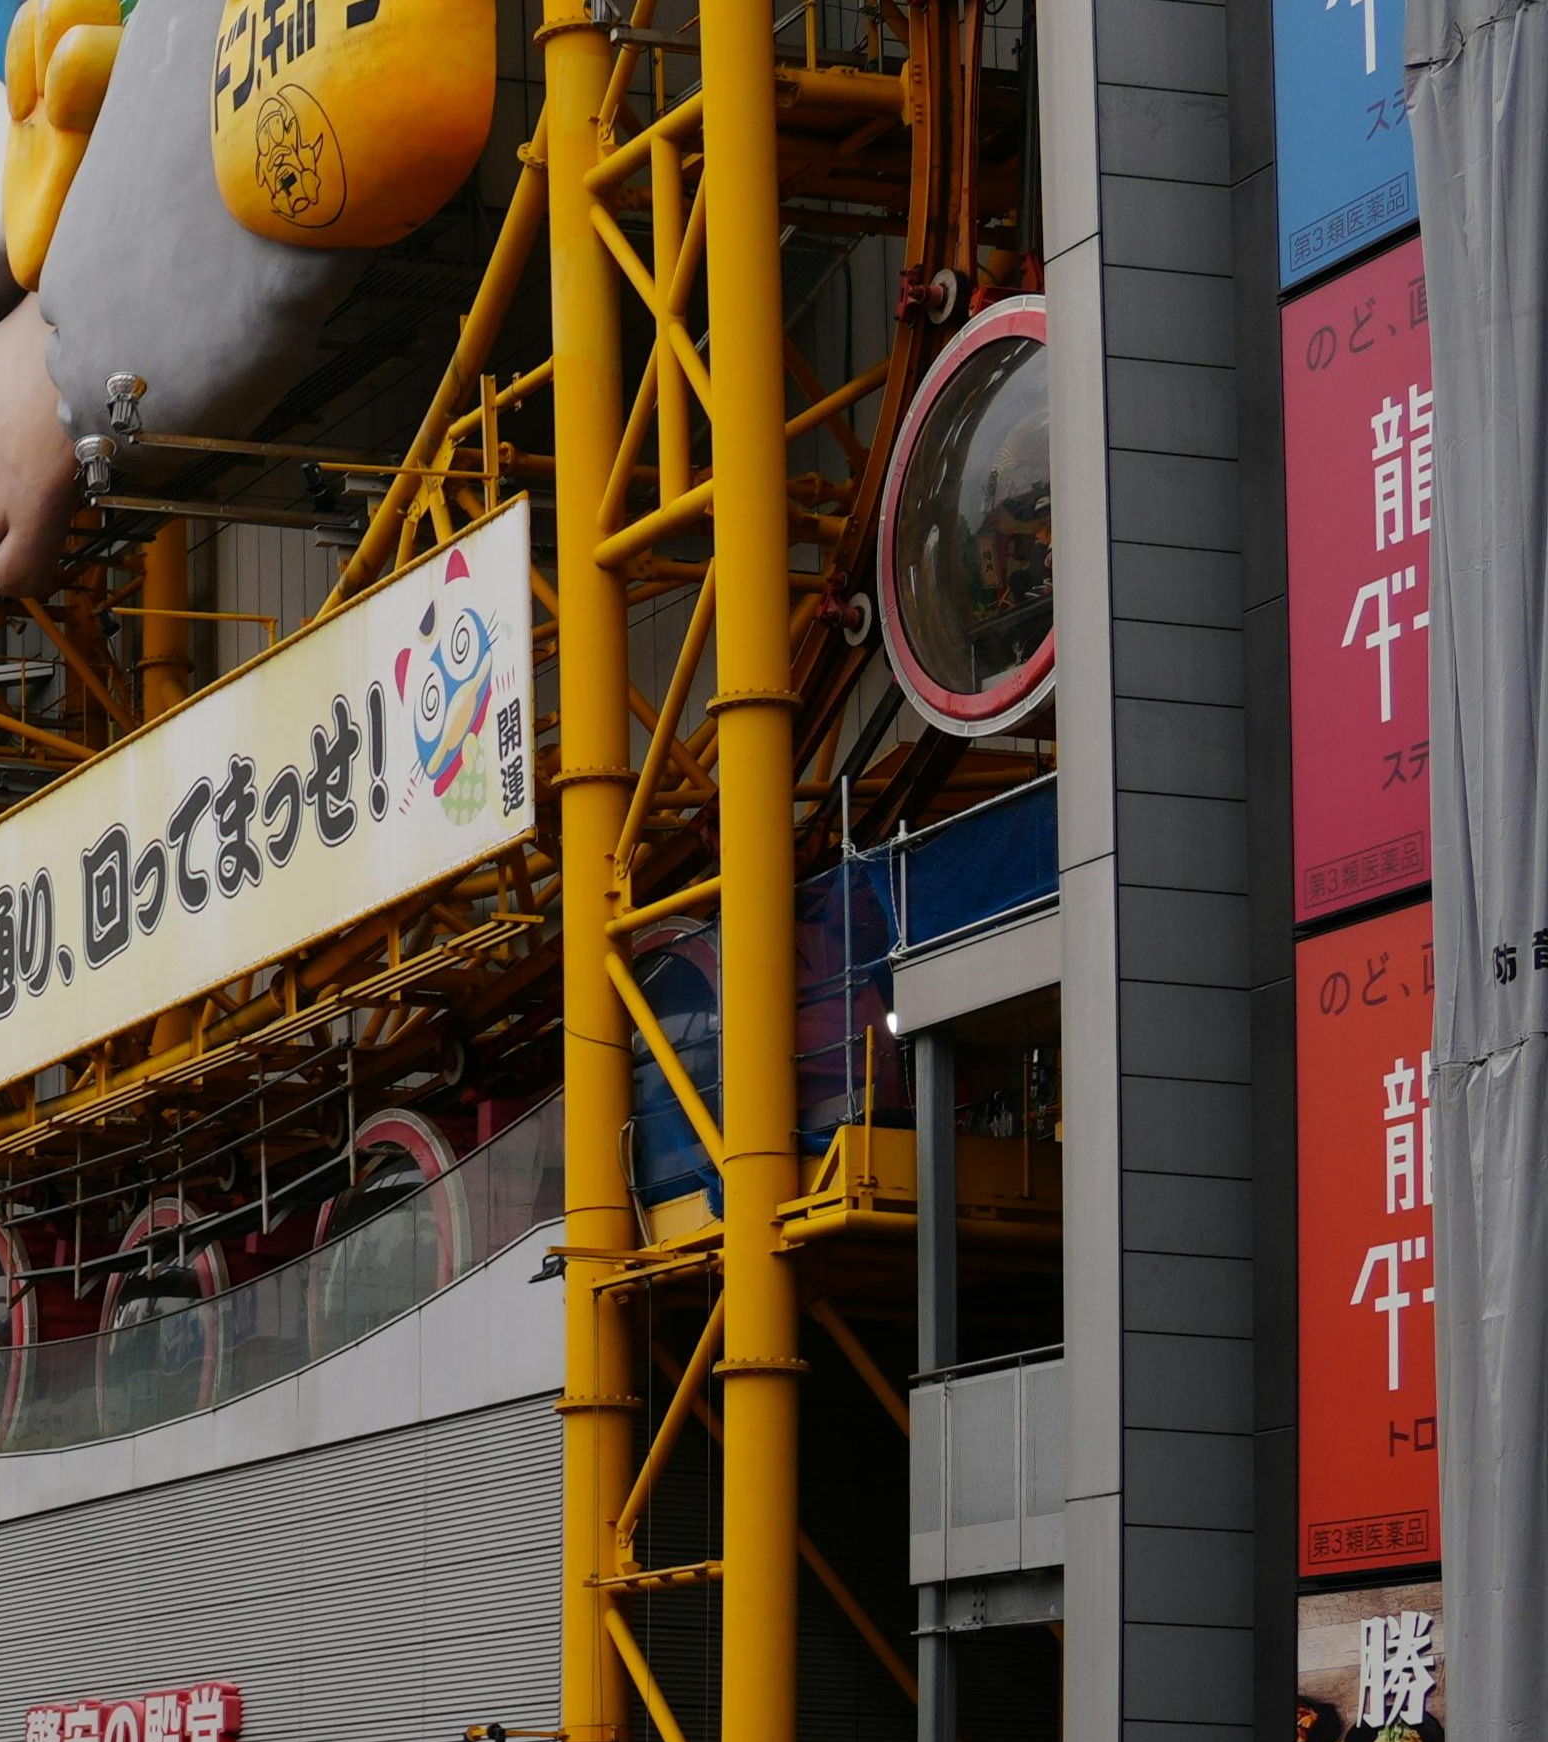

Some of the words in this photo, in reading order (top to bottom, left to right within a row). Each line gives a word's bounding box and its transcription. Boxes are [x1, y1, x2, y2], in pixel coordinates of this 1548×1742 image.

[1294, 186, 1406, 262] 第3類医薬品
[497, 697, 525, 817] 開運
[1309, 838, 1423, 901] 第3類医薬品
[1312, 1519, 1427, 1558] 第3類医薬品
[1356, 1610, 1435, 1729] 勝
